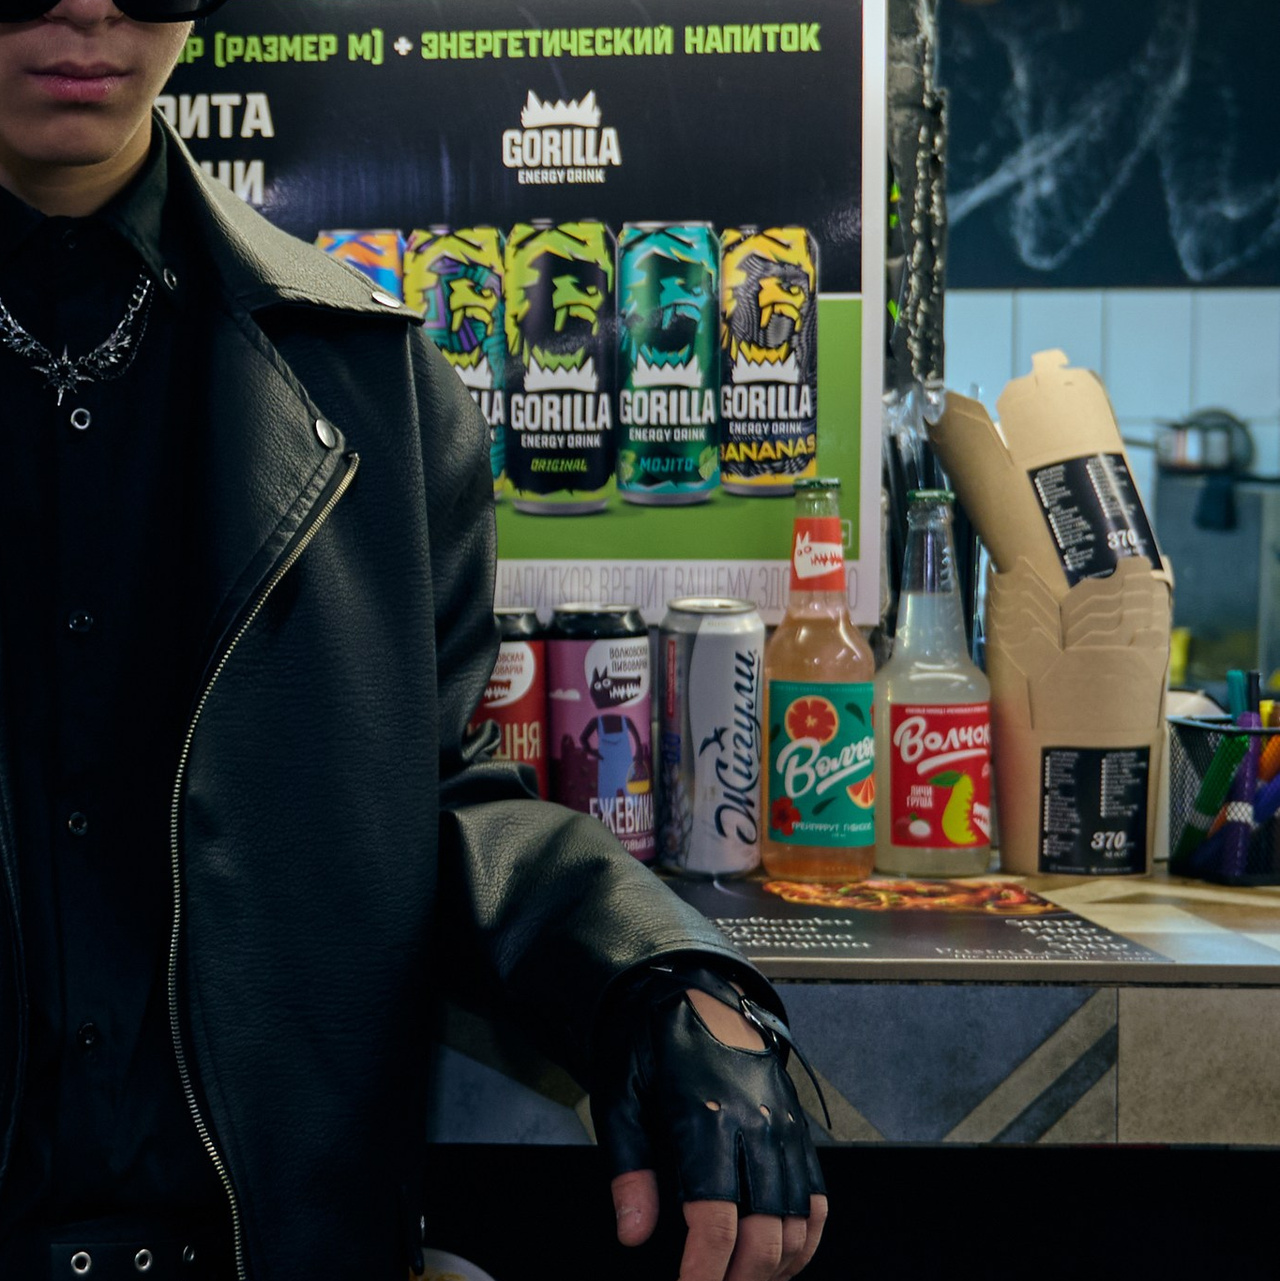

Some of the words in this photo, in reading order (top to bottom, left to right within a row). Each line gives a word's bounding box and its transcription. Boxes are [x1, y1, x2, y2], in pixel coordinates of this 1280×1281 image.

[421, 24, 674, 60] ЭНЕРГЕТИЧЕСКИЙ
[684, 22, 821, 54] НАПИТОК
[502, 126, 621, 168] GORILLA
[518, 169, 565, 184] ENERGY
[566, 168, 605, 183] DRINK
[621, 389, 715, 427] GORILLA
[721, 385, 812, 420] GORILLA
[510, 392, 612, 433] GORILLA
[629, 428, 672, 441] ENERGY
[673, 427, 706, 441] DRINK
[729, 422, 770, 435] ENERGY
[771, 422, 802, 435] DRINK
[521, 434, 566, 449] ENERGY
[567, 434, 601, 448] DRINK
[530, 458, 588, 472] ORIGINAL
[639, 457, 695, 472] MOJITO
[1090, 830, 1127, 850] 370
